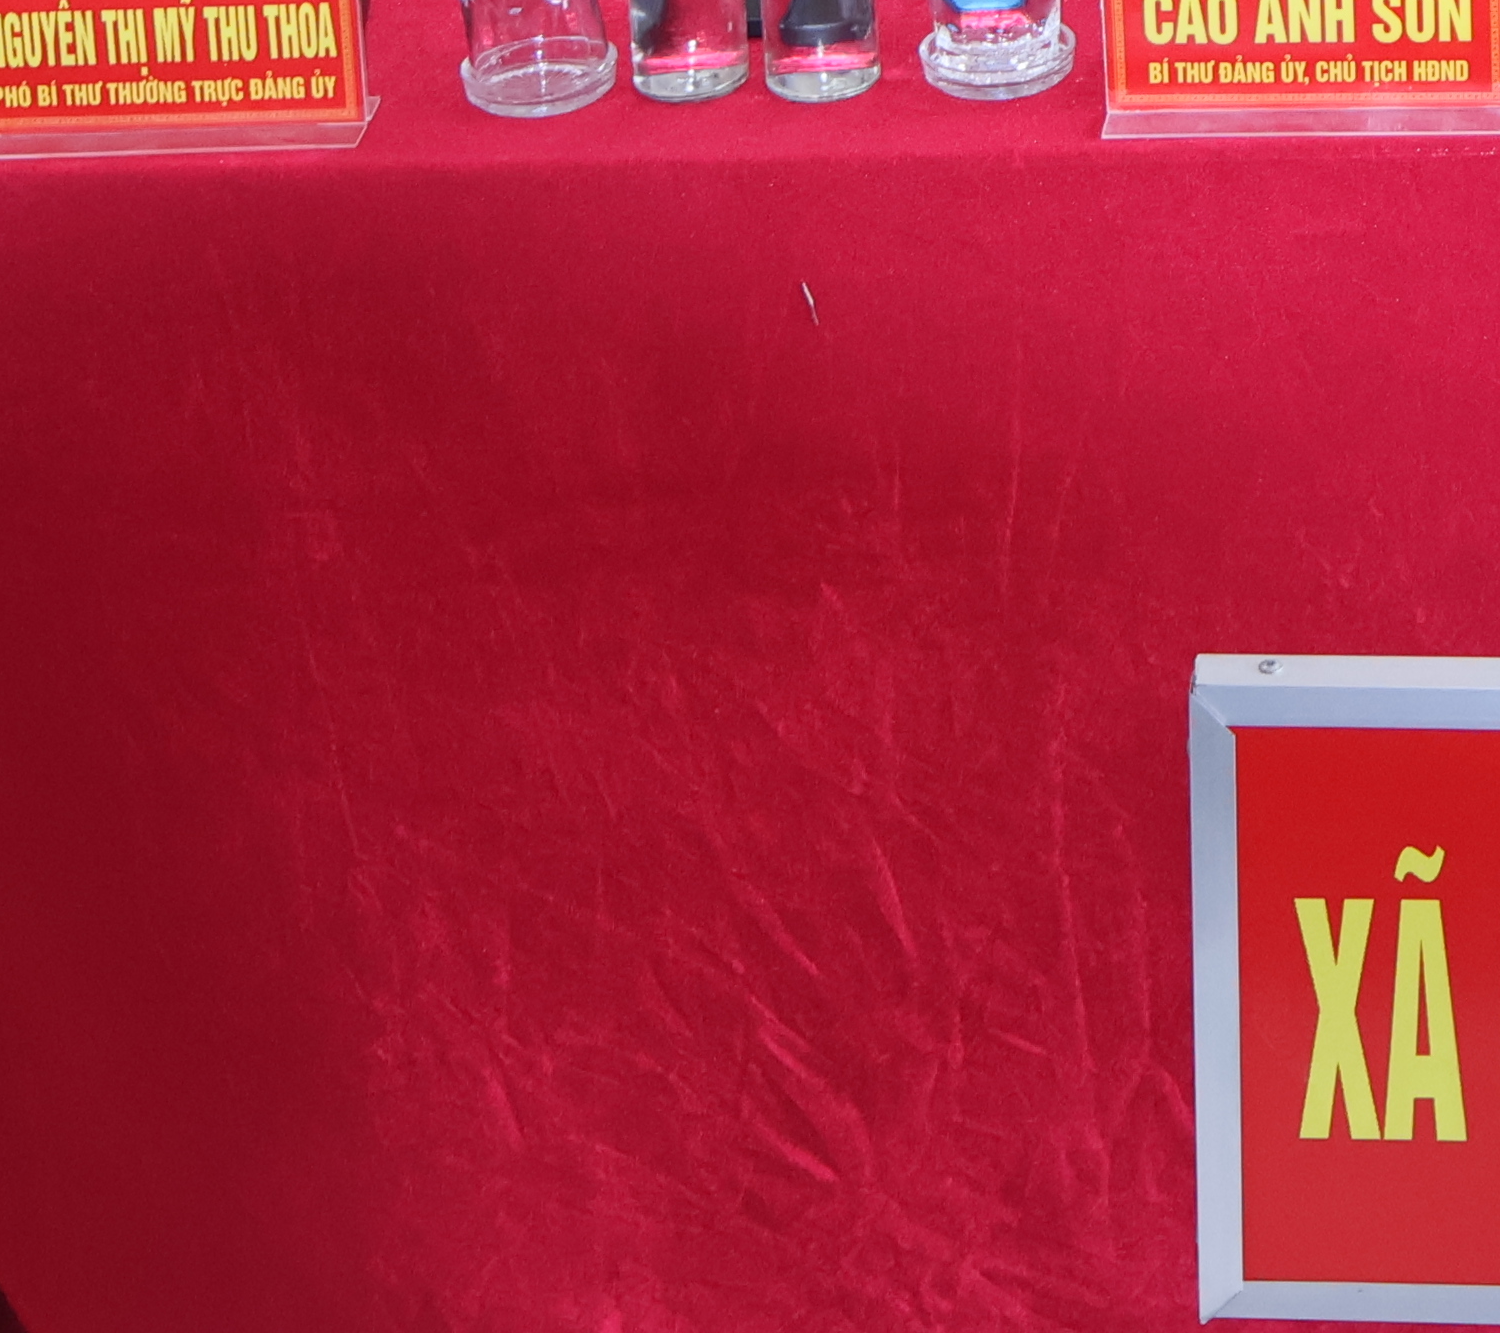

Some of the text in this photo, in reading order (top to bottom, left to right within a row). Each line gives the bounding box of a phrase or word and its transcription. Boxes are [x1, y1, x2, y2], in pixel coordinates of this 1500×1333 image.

[100, 7, 149, 76] THỊ
[202, 2, 259, 63] THU
[262, 1, 338, 60] THOA
[37, 79, 59, 107] BÍ
[62, 79, 103, 107] THƯ
[106, 74, 188, 106] THƯỜNG
[191, 76, 245, 108] TRỰC
[248, 71, 306, 102] ĐẢNG
[310, 68, 337, 100] ỦY
[1148, 53, 1469, 88] BÍ THƯ ĐẢNG ỦY, CHỦ TỊCH HĐND
[1294, 844, 1468, 1141] XÃ
